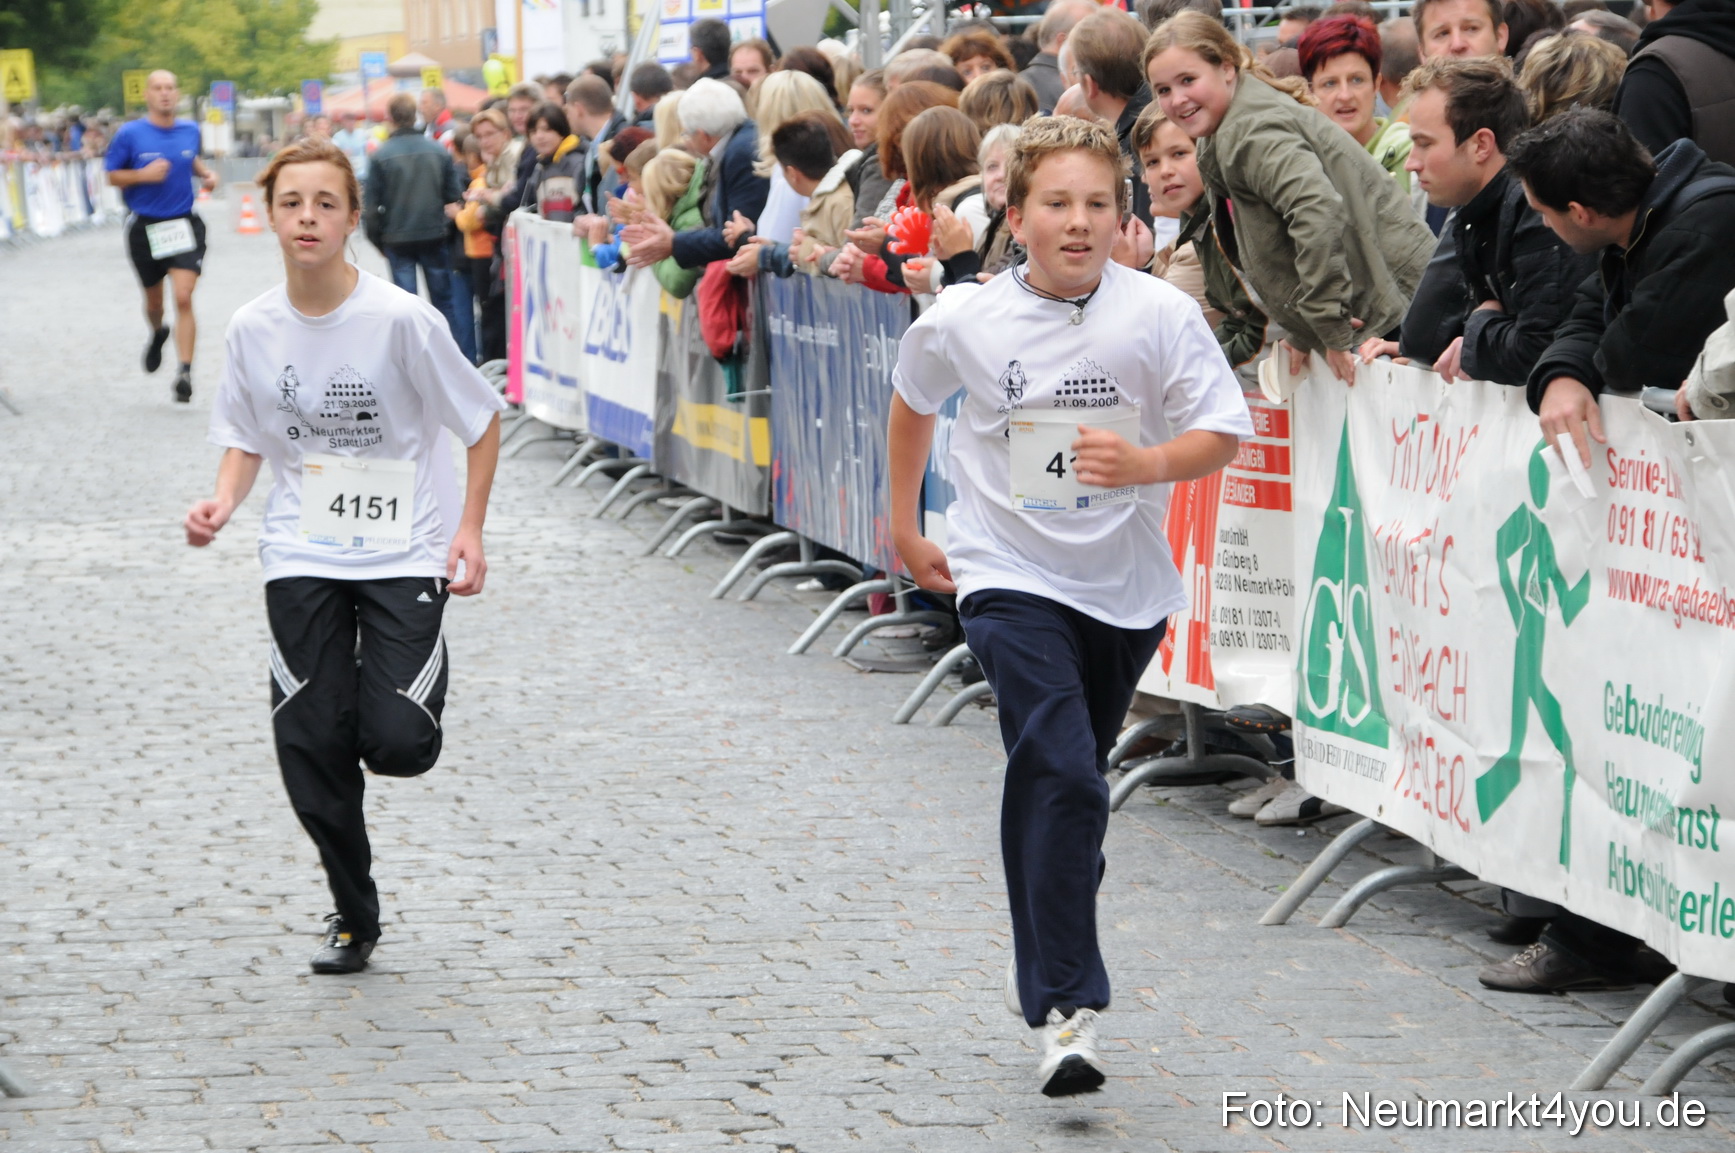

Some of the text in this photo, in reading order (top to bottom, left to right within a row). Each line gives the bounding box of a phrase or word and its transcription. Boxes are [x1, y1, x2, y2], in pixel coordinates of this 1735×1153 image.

[324, 398, 377, 410] 21.09.2008
[1053, 395, 1119, 408] 21.09.2008
[311, 426, 381, 438] Neumarkter
[328, 434, 384, 449] Stadtlauf
[1090, 486, 1136, 503] PFLEIDERER
[328, 493, 398, 522] 4151
[1252, 553, 1259, 572] 8
[1219, 629, 1249, 649] 09181
[1255, 632, 1291, 653] 2307-70
